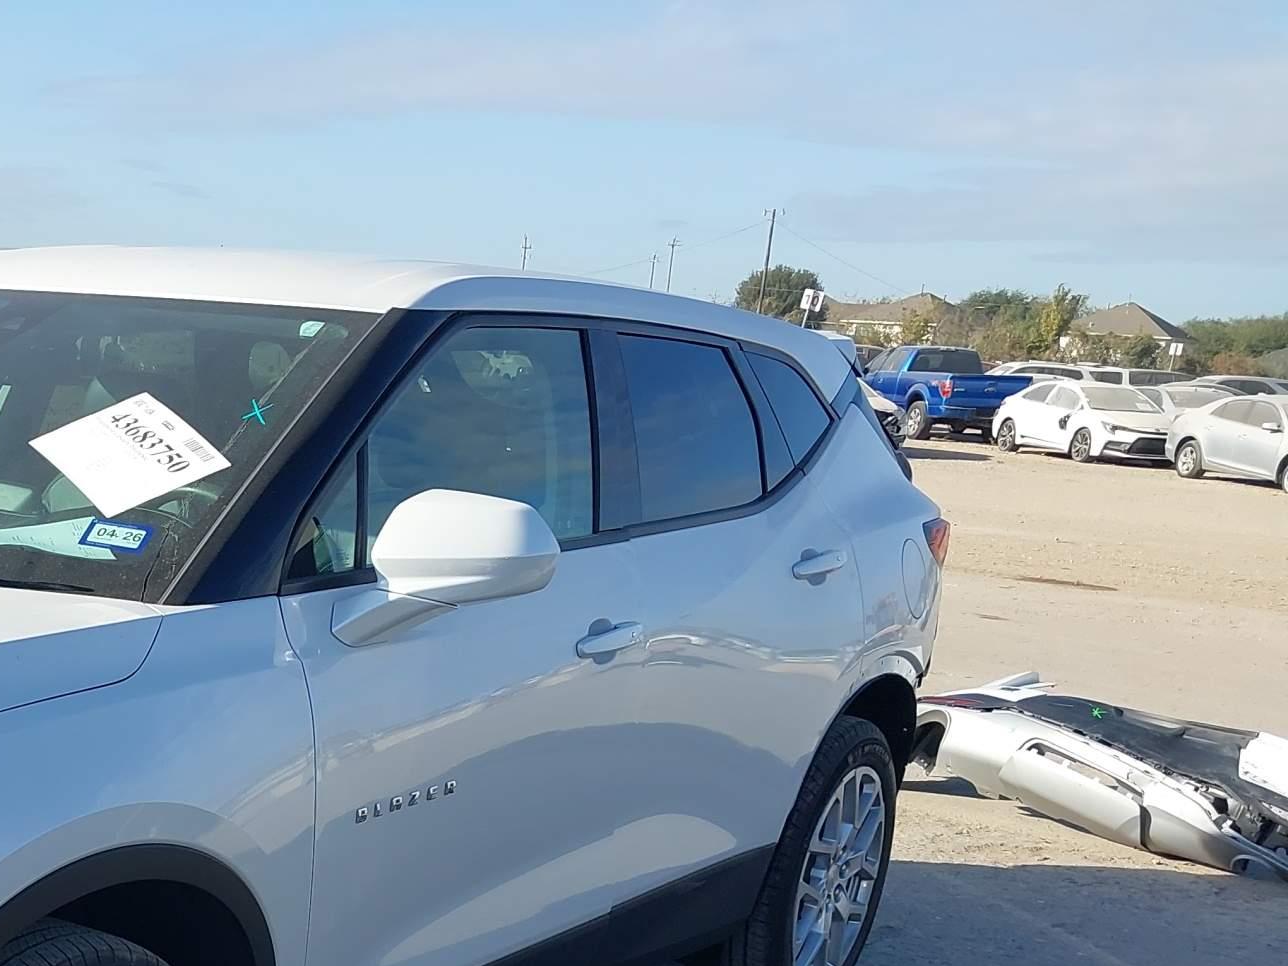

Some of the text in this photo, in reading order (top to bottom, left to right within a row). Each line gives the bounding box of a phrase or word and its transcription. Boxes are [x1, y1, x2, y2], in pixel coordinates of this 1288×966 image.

[111, 413, 191, 473] 43683750
[122, 531, 143, 543] 26
[355, 780, 457, 824] BLAZER
